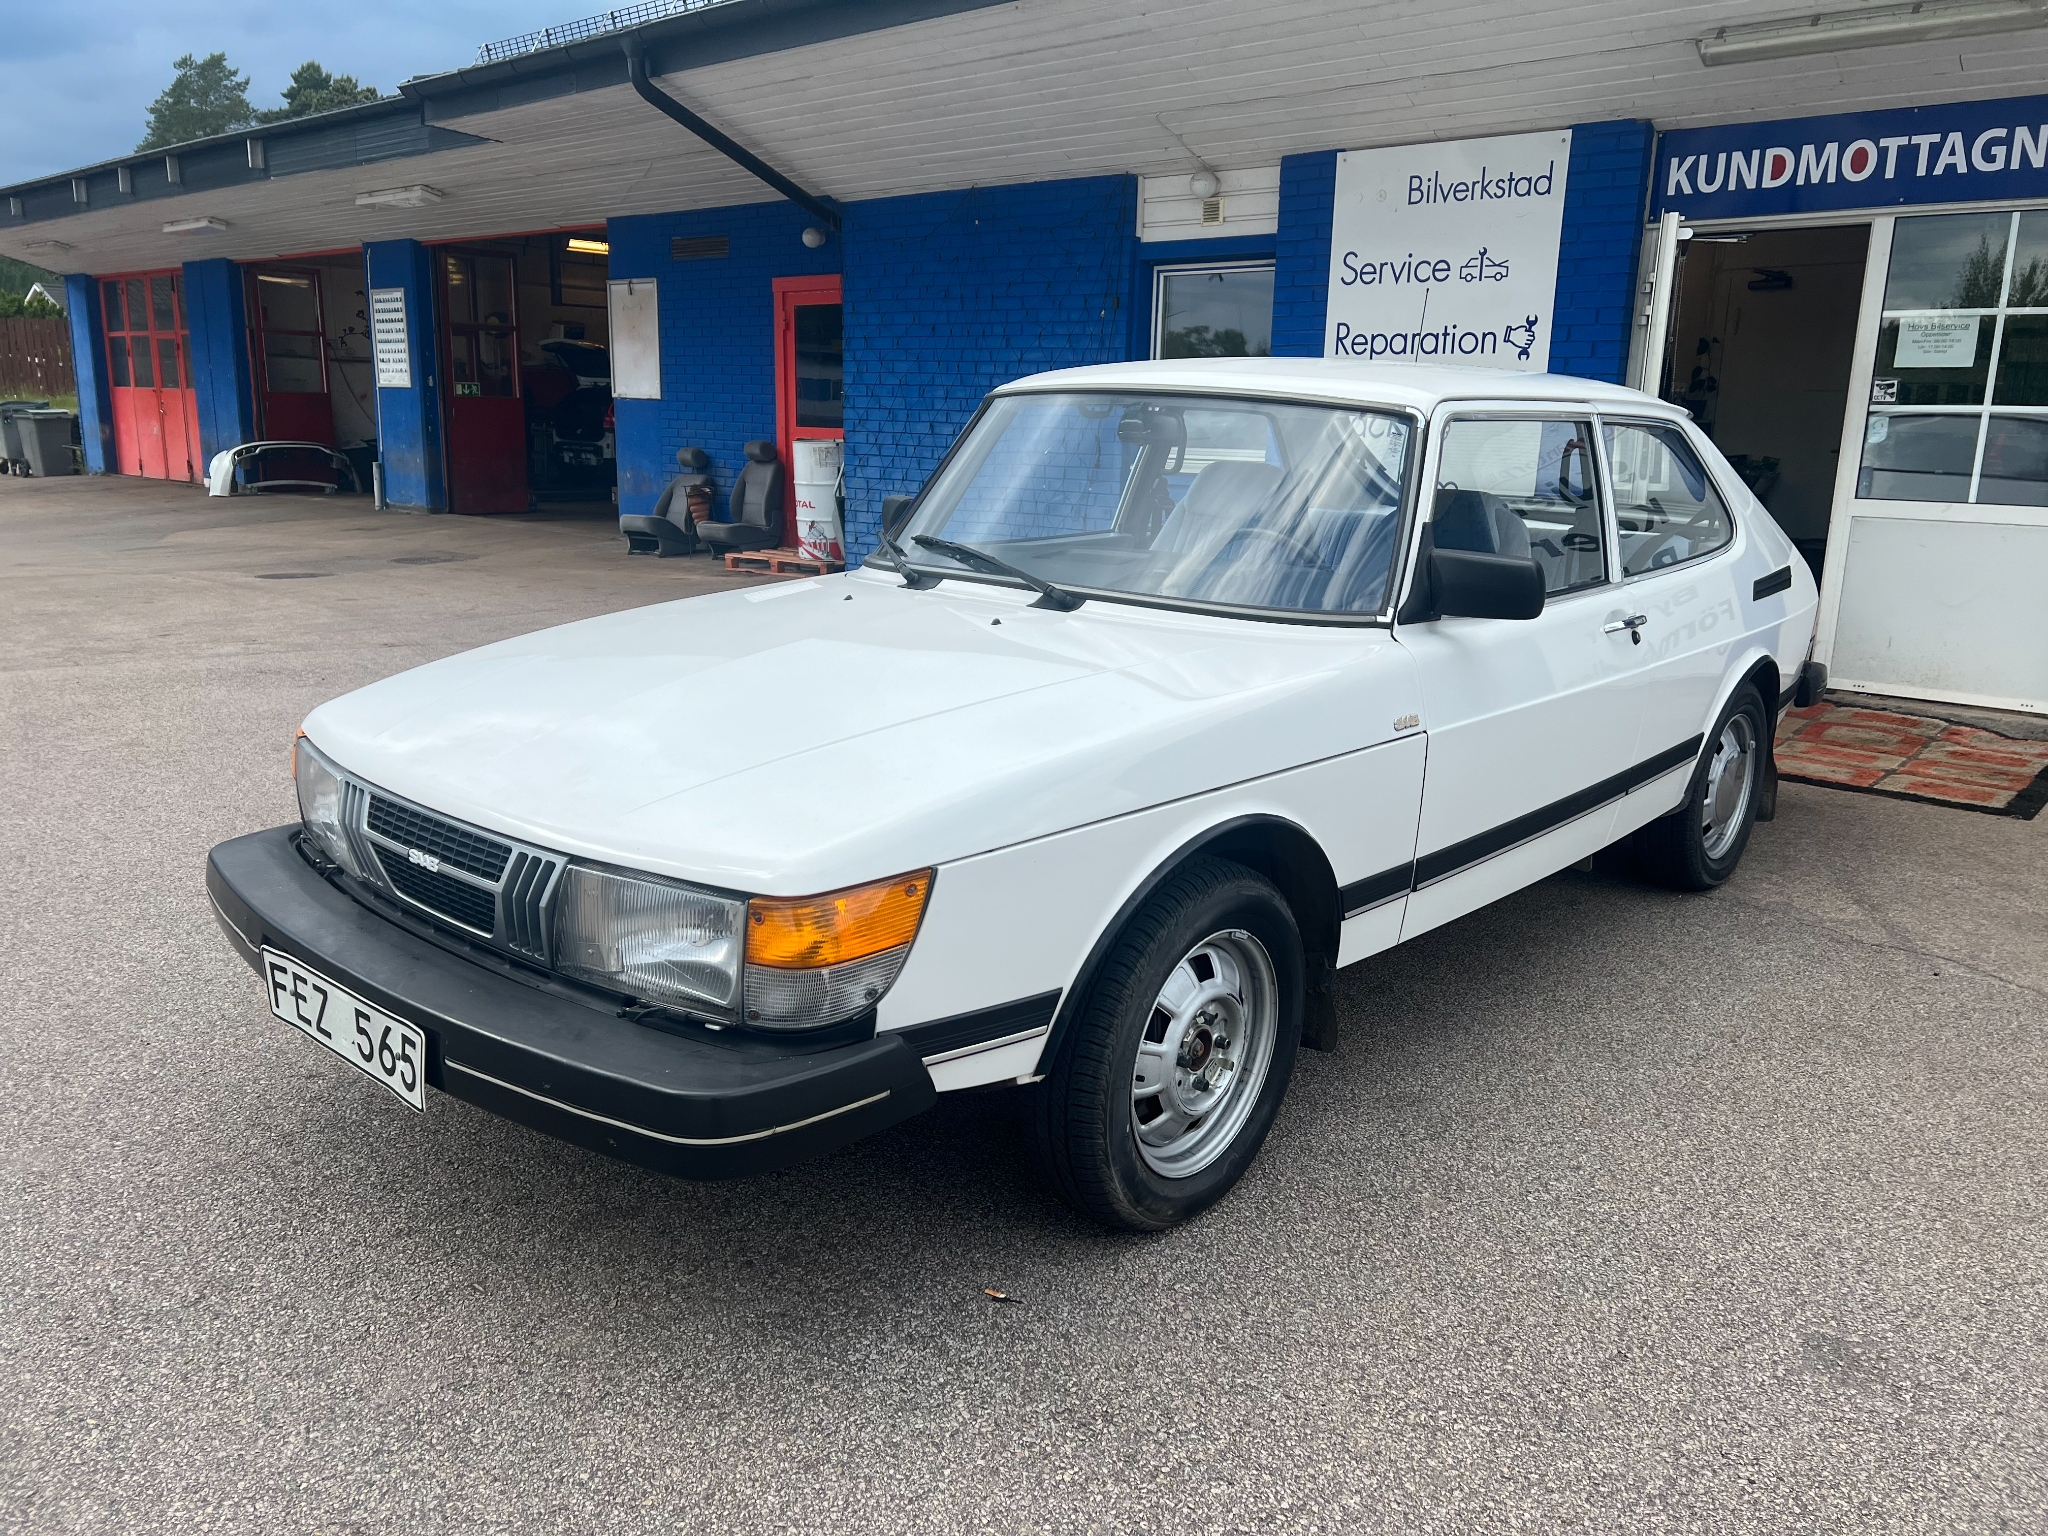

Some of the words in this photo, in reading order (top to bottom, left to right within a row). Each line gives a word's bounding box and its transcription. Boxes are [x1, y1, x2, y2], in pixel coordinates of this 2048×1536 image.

[1667, 125, 2048, 196] KUNDMOTTAGN
[1407, 160, 1554, 205] Bilverkstad
[1340, 251, 1451, 286] Service
[1335, 322, 1497, 361] Reparation
[1930, 323, 1971, 331] Bilservice
[408, 848, 439, 873] SAAB
[268, 960, 332, 1041] FEZ
[354, 1006, 417, 1093] 565
